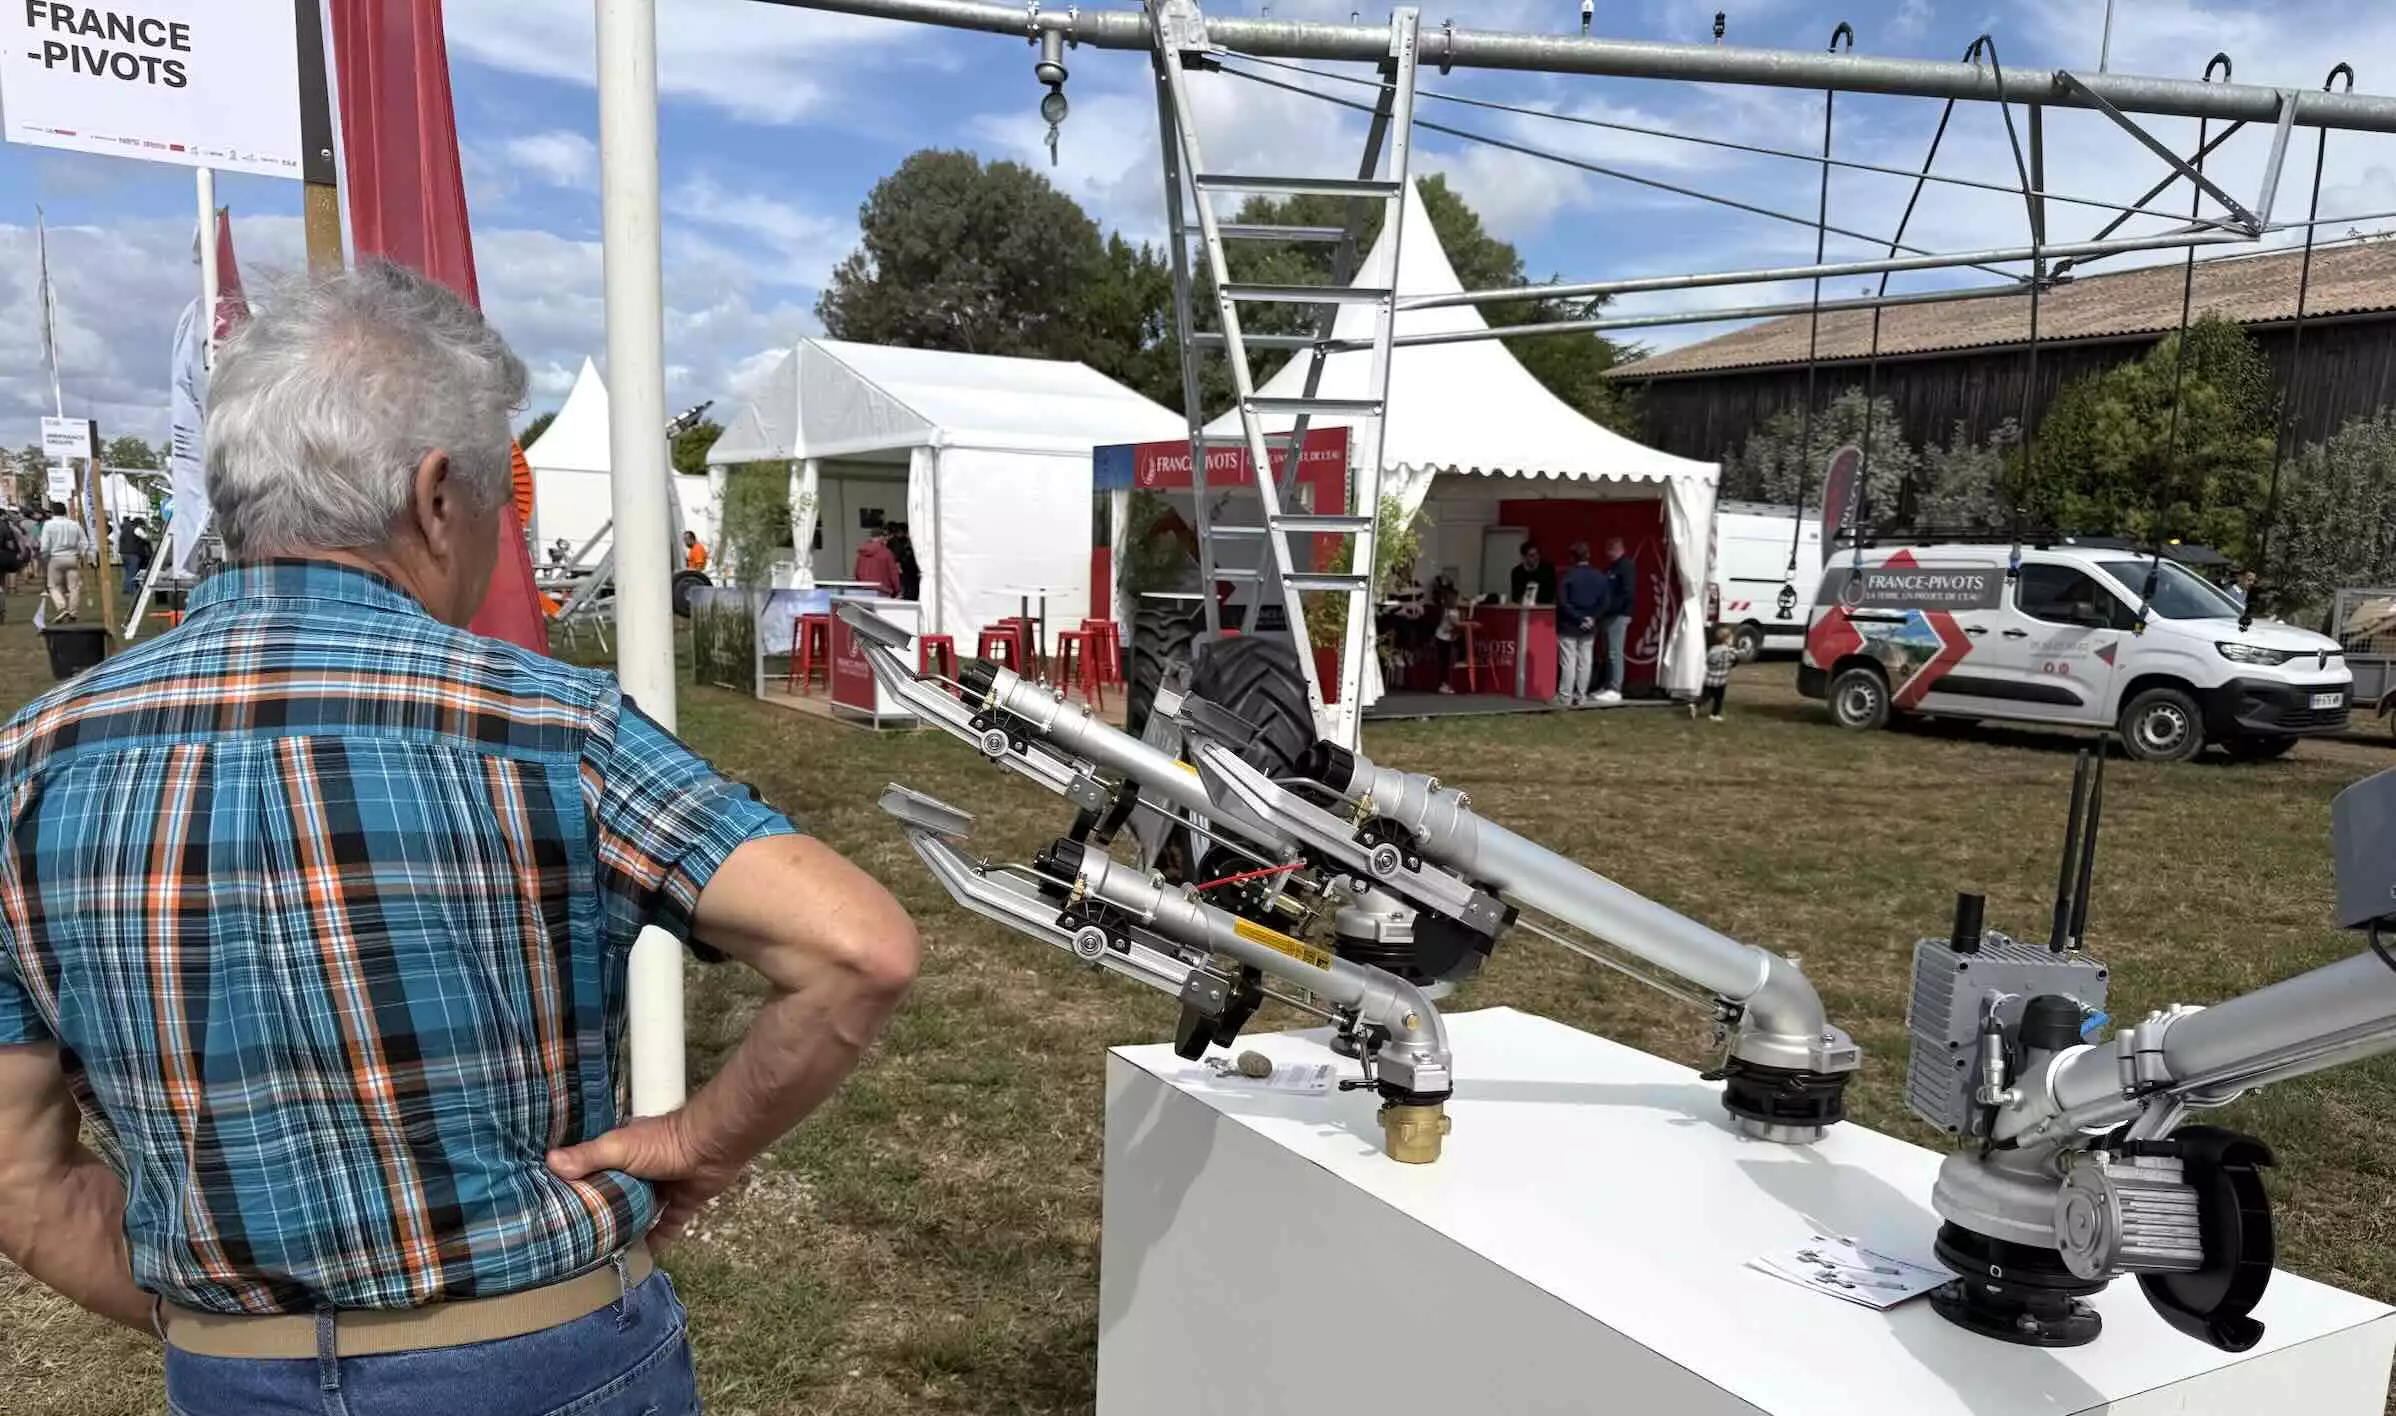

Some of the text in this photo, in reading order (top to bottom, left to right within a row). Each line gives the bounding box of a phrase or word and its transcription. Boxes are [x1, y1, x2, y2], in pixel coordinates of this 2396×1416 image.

[25, 0, 192, 52] FRANCE
[27, 40, 188, 88] -PIVOTS
[1868, 575, 1984, 590] FRANCE-PIVOTS
